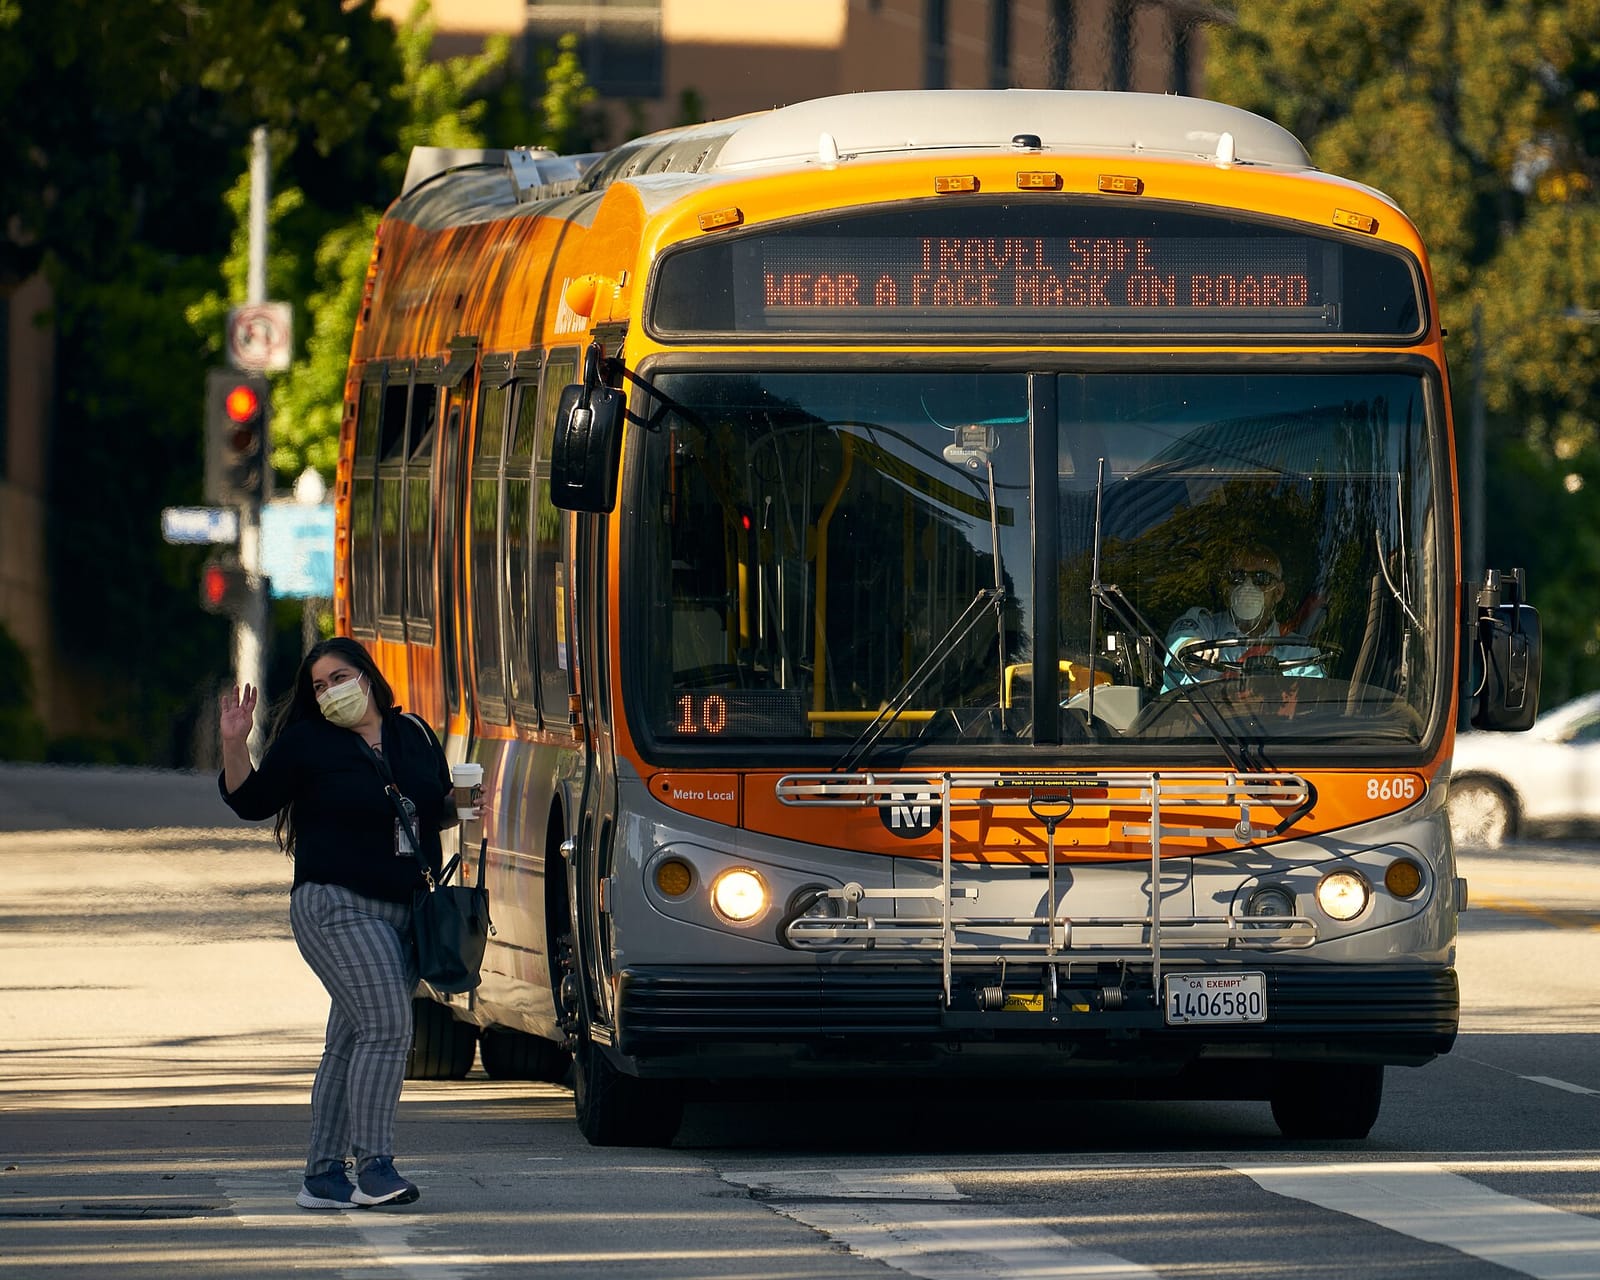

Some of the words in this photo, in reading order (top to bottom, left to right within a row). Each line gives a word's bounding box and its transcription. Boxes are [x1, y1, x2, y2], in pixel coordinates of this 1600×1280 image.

[921, 239, 1053, 271] TRAVEL
[1069, 239, 1155, 271] SAFE
[765, 274, 860, 306] WEAR
[874, 274, 897, 306] A
[912, 274, 999, 306] FACE
[1014, 274, 1111, 306] MASK
[1126, 274, 1176, 306] ON
[1191, 274, 1309, 306] BOARD
[677, 694, 727, 733] 10
[673, 789, 704, 800] Metro
[707, 790, 734, 801] Local
[1366, 778, 1415, 800] 8605
[891, 791, 931, 828] M
[1189, 981, 1202, 989] CA
[1206, 980, 1241, 988] EXEMPT
[1172, 991, 1260, 1017] 1406580
